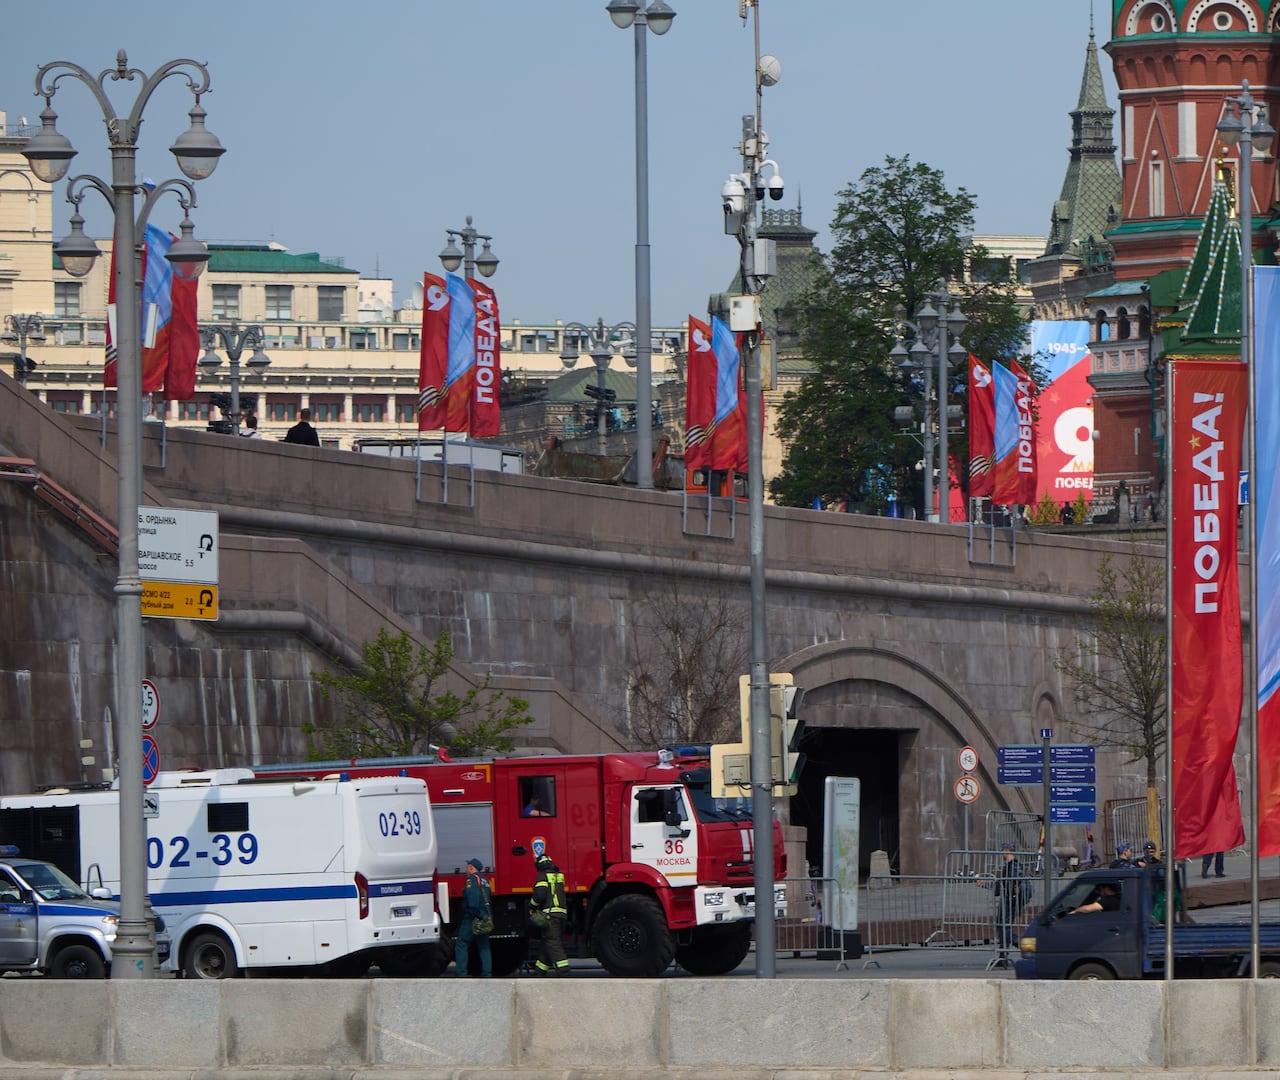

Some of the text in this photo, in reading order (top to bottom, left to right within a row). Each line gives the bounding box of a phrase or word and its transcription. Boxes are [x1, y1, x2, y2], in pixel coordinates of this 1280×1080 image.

[427, 284, 450, 311] 9
[476, 289, 498, 403] ПОБЕДА!
[973, 364, 992, 388] 9
[1017, 373, 1034, 473] ПОБЕДА!
[1191, 392, 1225, 614] ПОБЕДА!
[146, 515, 177, 525] ОРДЫНКА
[138, 551, 182, 561] ВАРШАВСКОЕ
[184, 559, 194, 567] 5.5
[379, 811, 421, 837] 02-39
[146, 833, 259, 869] 02-39
[664, 839, 684, 854] 36
[656, 858, 691, 866] МОСКВА
